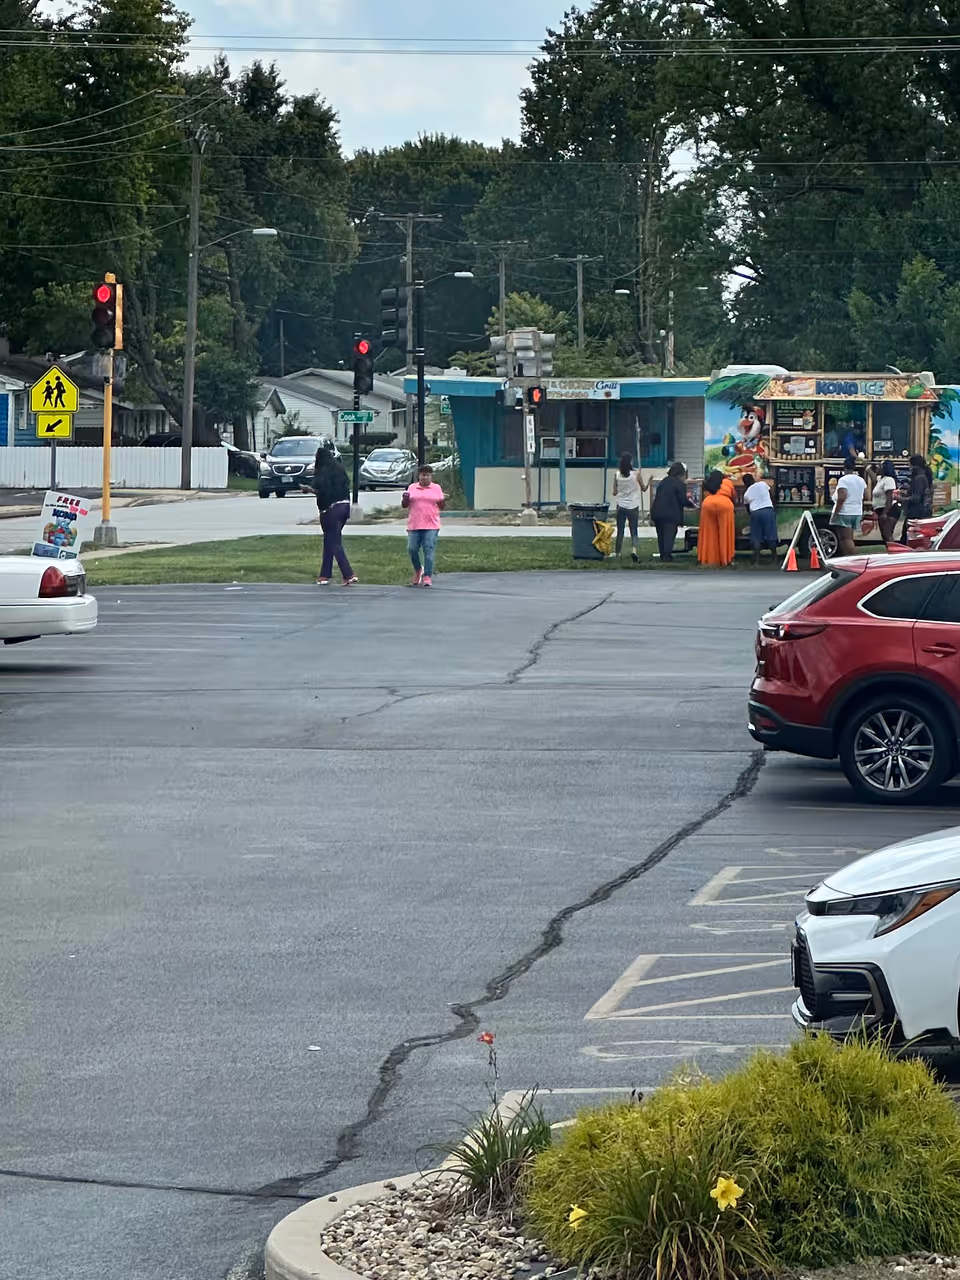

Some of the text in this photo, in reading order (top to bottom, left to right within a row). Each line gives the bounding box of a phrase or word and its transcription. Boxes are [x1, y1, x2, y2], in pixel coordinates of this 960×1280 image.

[815, 380, 885, 396] KONA ICE
[339, 412, 357, 421] Cook
[57, 496, 81, 507] FREE
